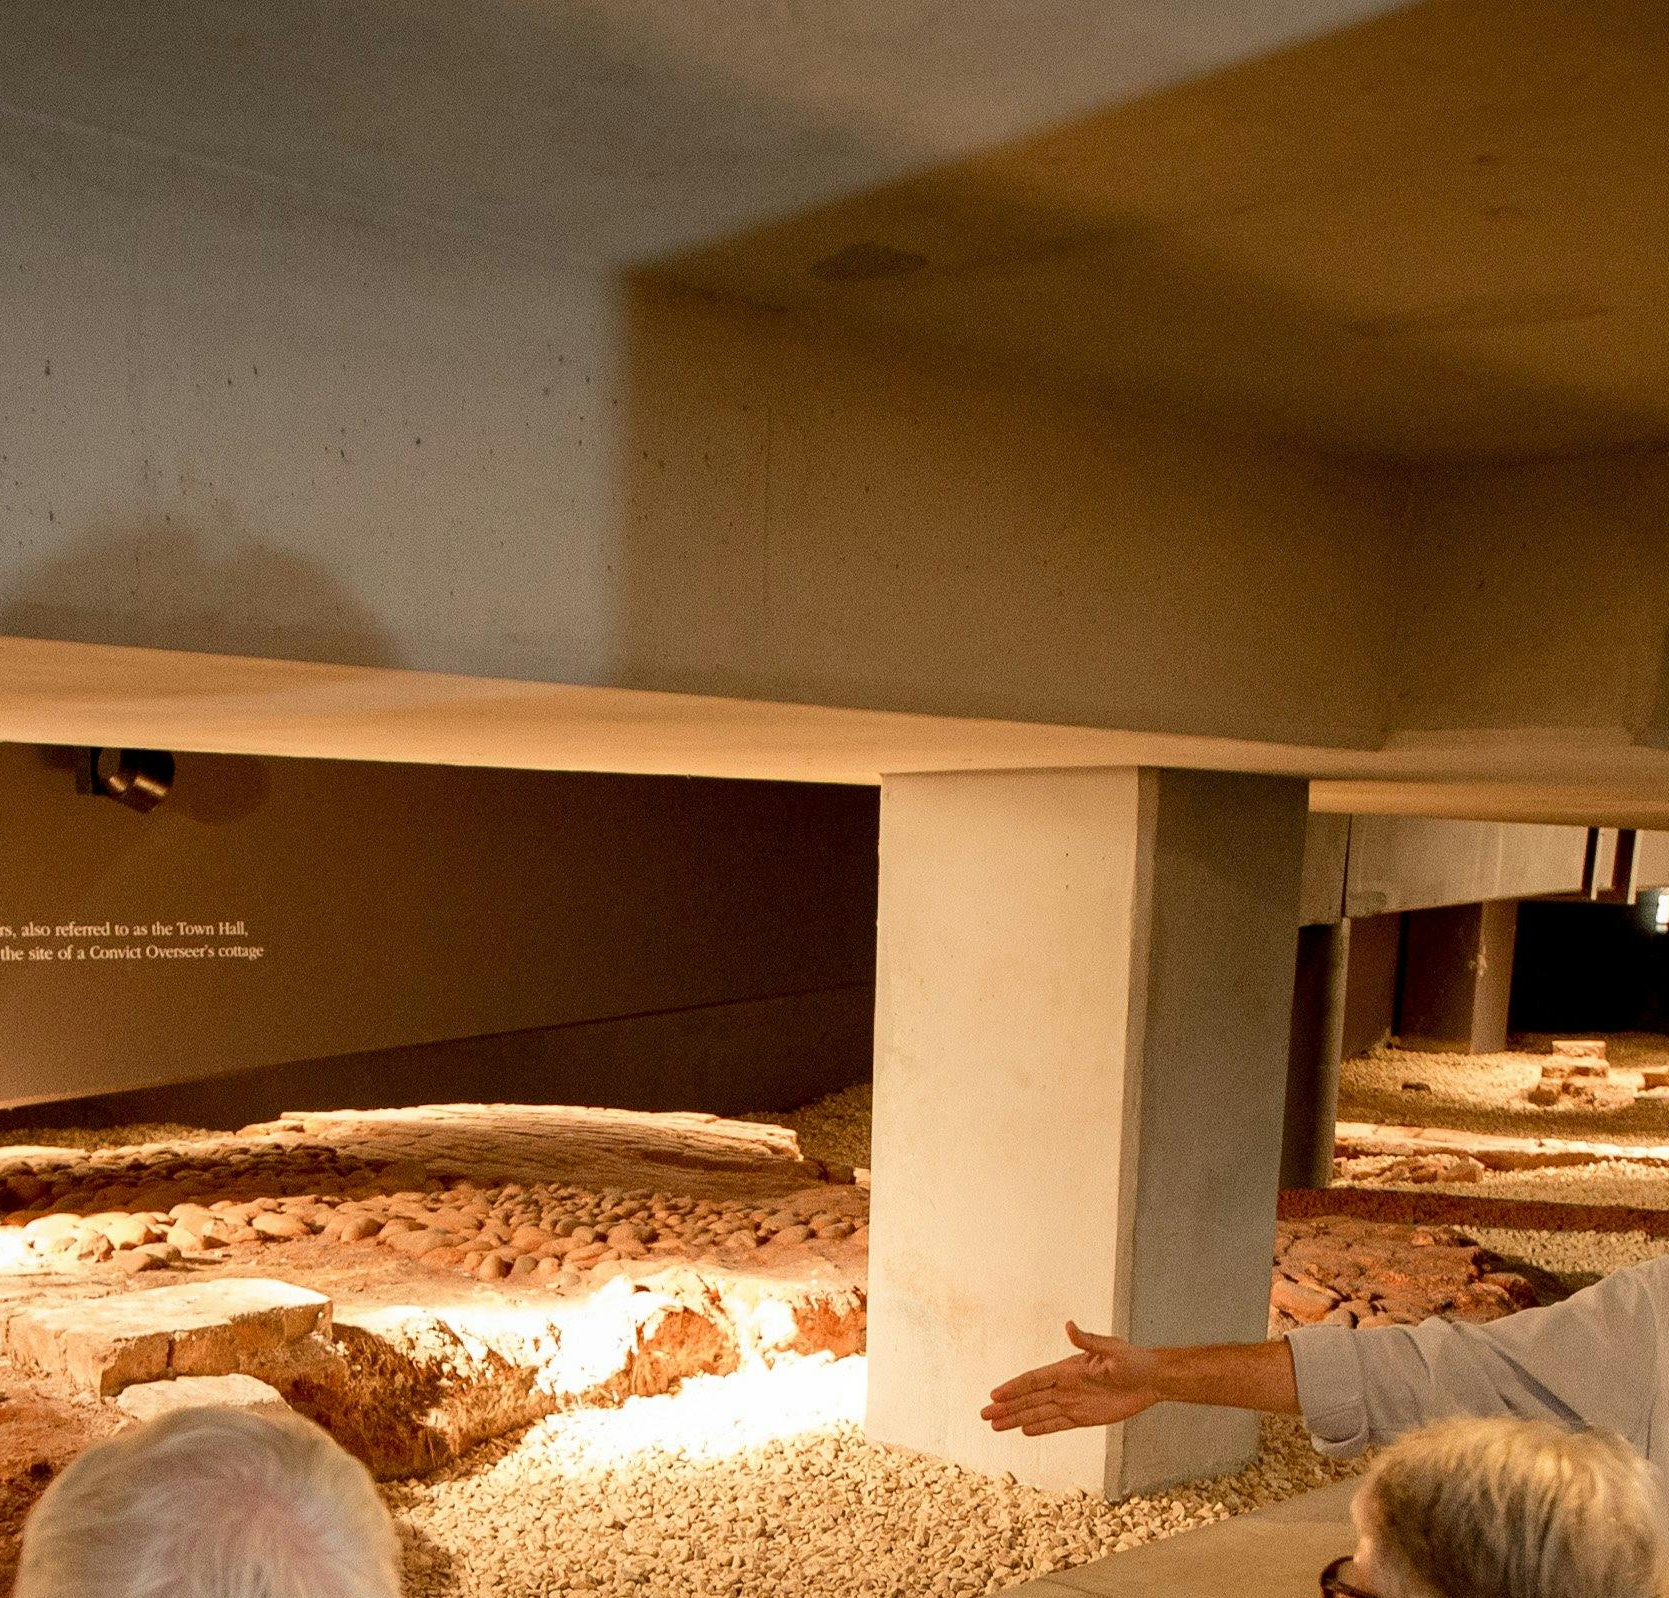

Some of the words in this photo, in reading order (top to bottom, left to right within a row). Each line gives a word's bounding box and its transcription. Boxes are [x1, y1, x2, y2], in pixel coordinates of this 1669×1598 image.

[21, 922, 51, 937] also
[55, 921, 110, 936] referred
[115, 923, 129, 936] to
[133, 925, 148, 936] as
[152, 921, 173, 936] the
[176, 921, 214, 936] Town
[219, 921, 248, 937] Hall,
[0, 946, 24, 961] the
[28, 946, 53, 960] site
[57, 944, 74, 960] of
[77, 948, 84, 960] a
[89, 945, 141, 959] Convict
[218, 944, 264, 960] cottage
